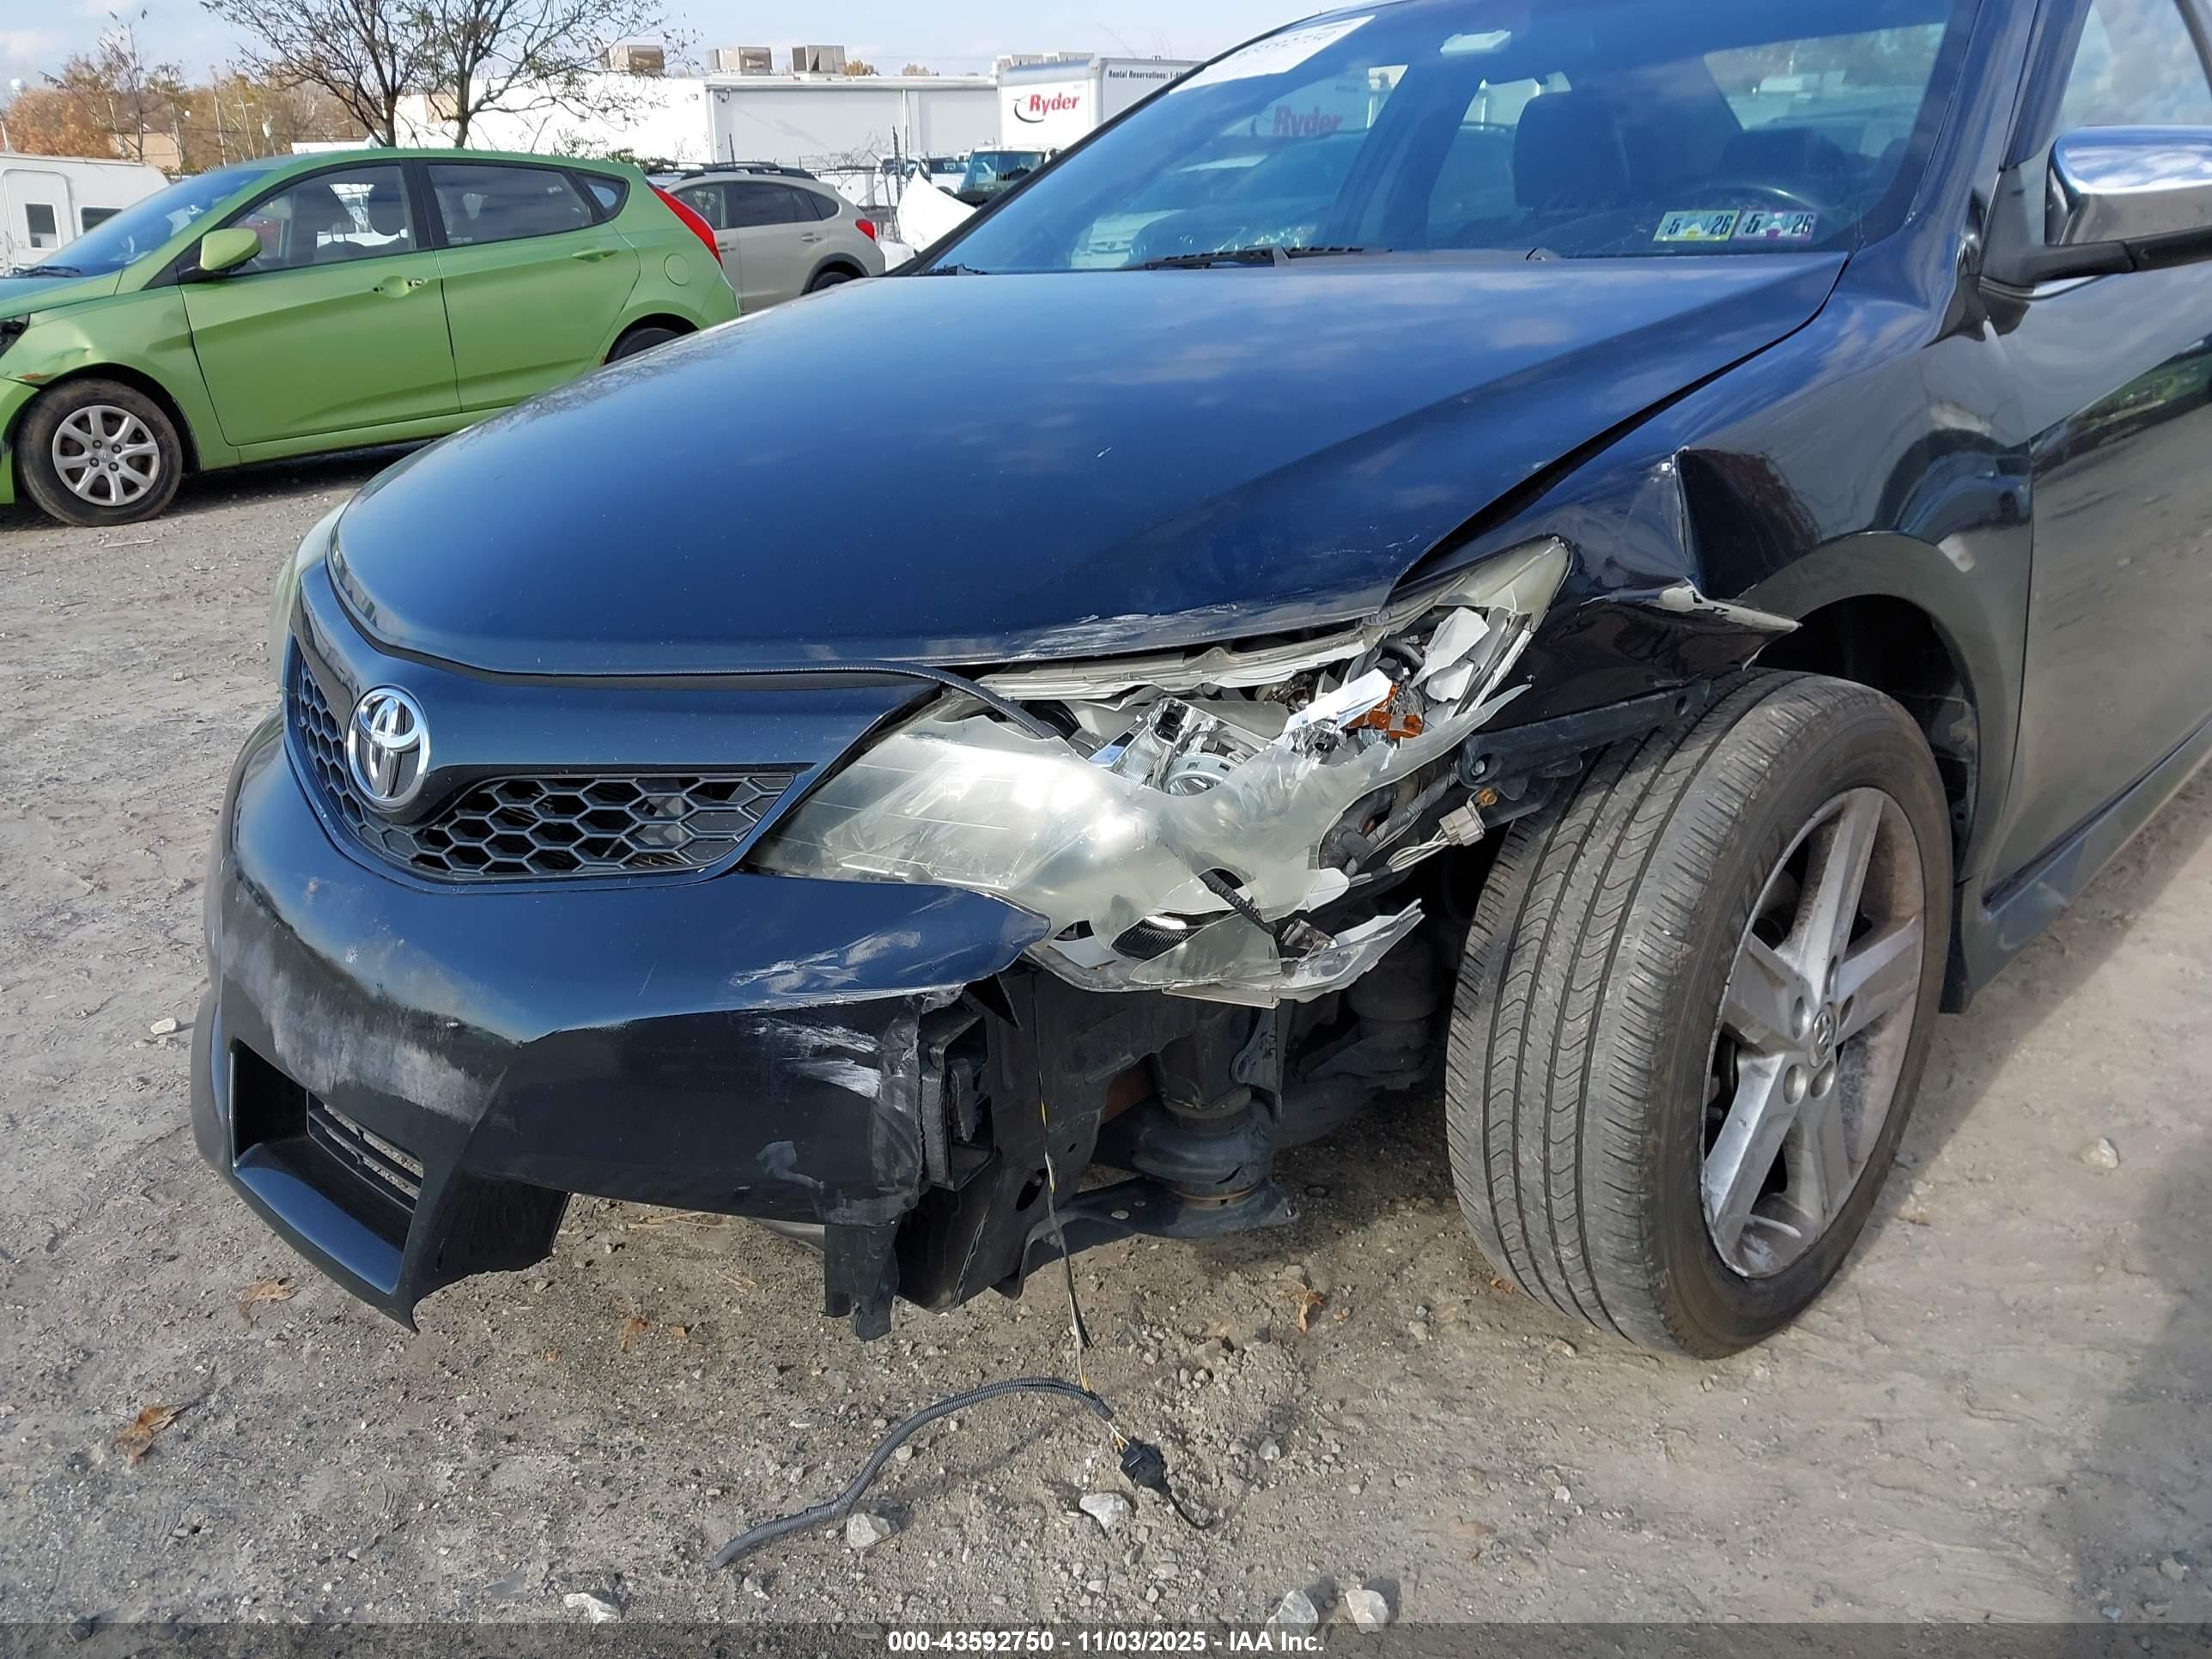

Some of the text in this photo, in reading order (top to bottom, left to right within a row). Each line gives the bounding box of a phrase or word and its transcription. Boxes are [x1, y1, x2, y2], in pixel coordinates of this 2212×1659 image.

[1108, 70, 1127, 78] Rental
[1128, 70, 1168, 79] Reservations:
[1029, 92, 1080, 116] Ryder
[1273, 106, 1343, 137] Ryder
[1668, 215, 1733, 235] 5 26
[1745, 213, 1814, 234] 5 26
